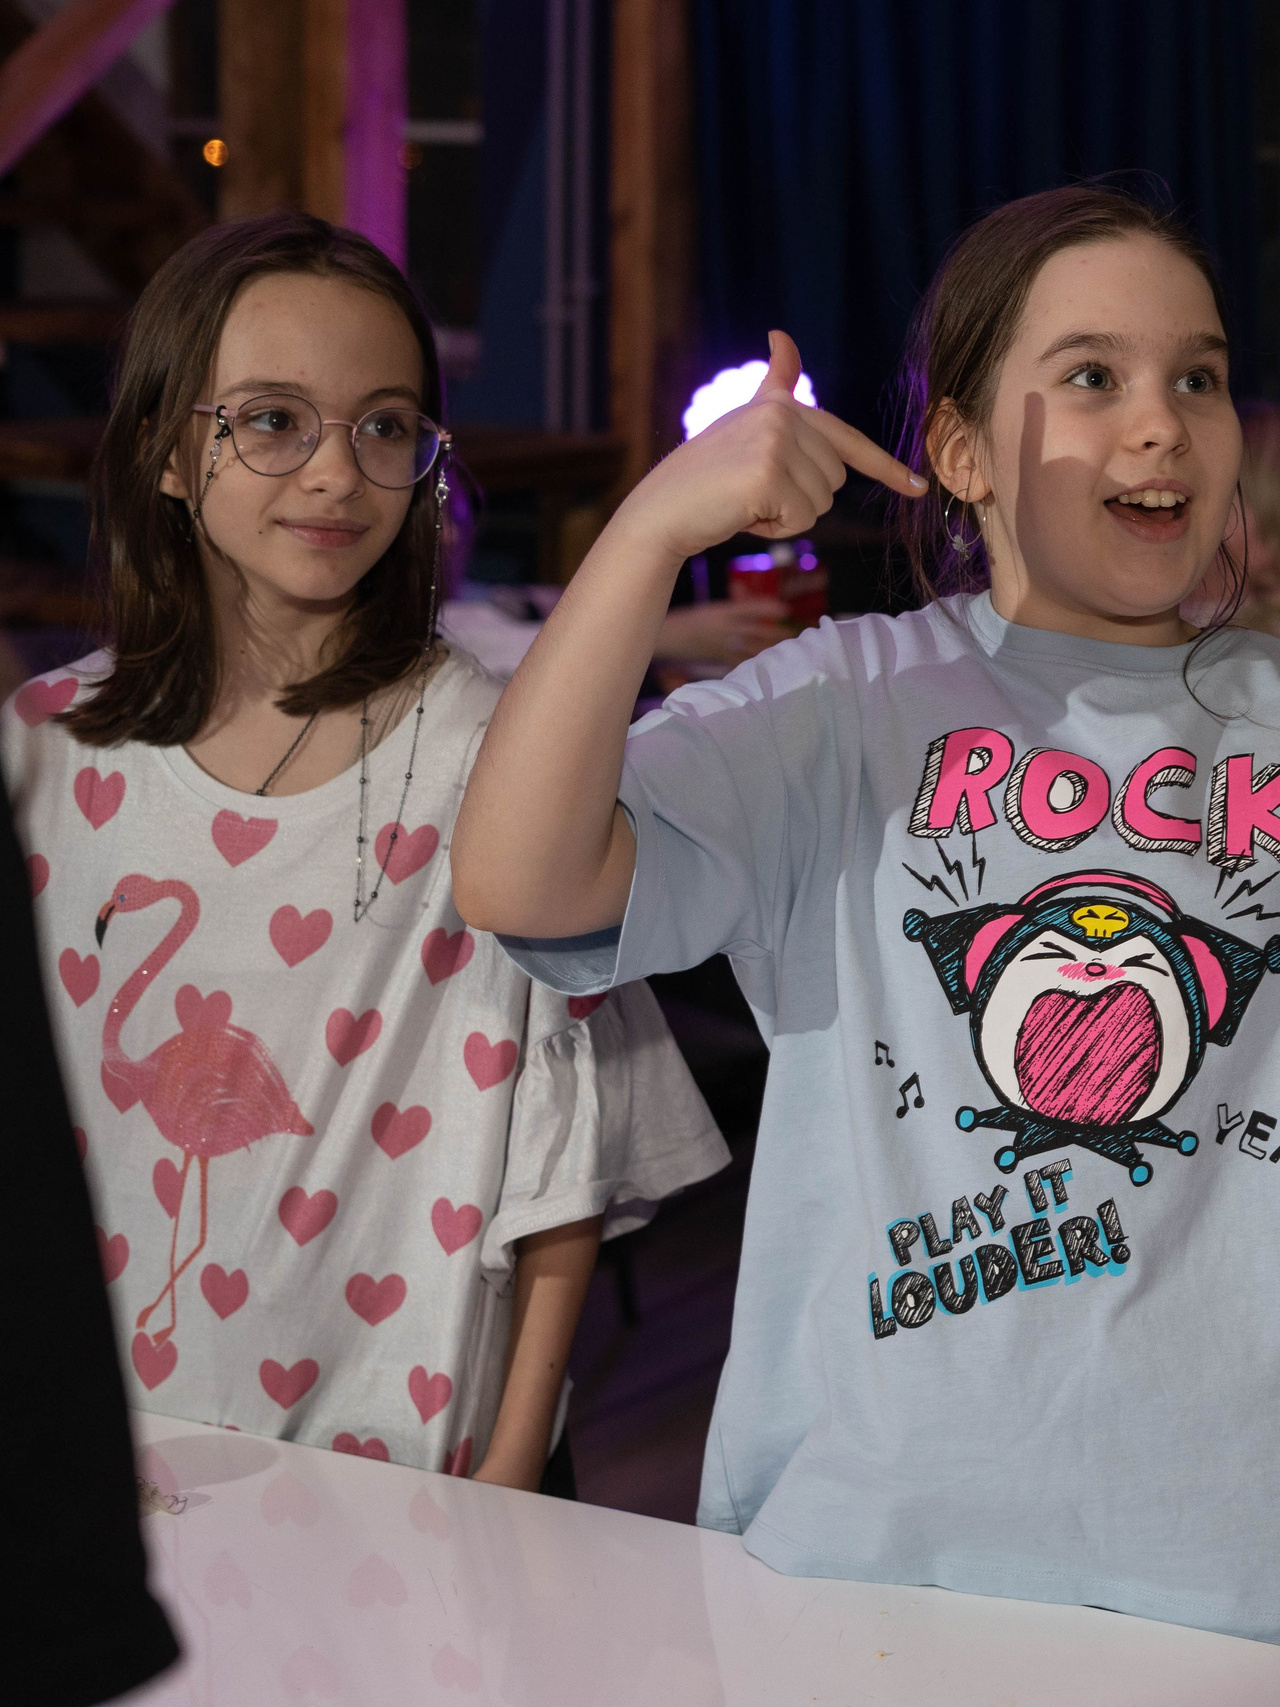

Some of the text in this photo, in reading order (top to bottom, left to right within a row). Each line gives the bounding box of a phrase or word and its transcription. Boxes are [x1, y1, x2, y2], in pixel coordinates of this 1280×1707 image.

[868, 1197, 1131, 1340] LOUDER!
[887, 1158, 1074, 1266] PLAY IT
